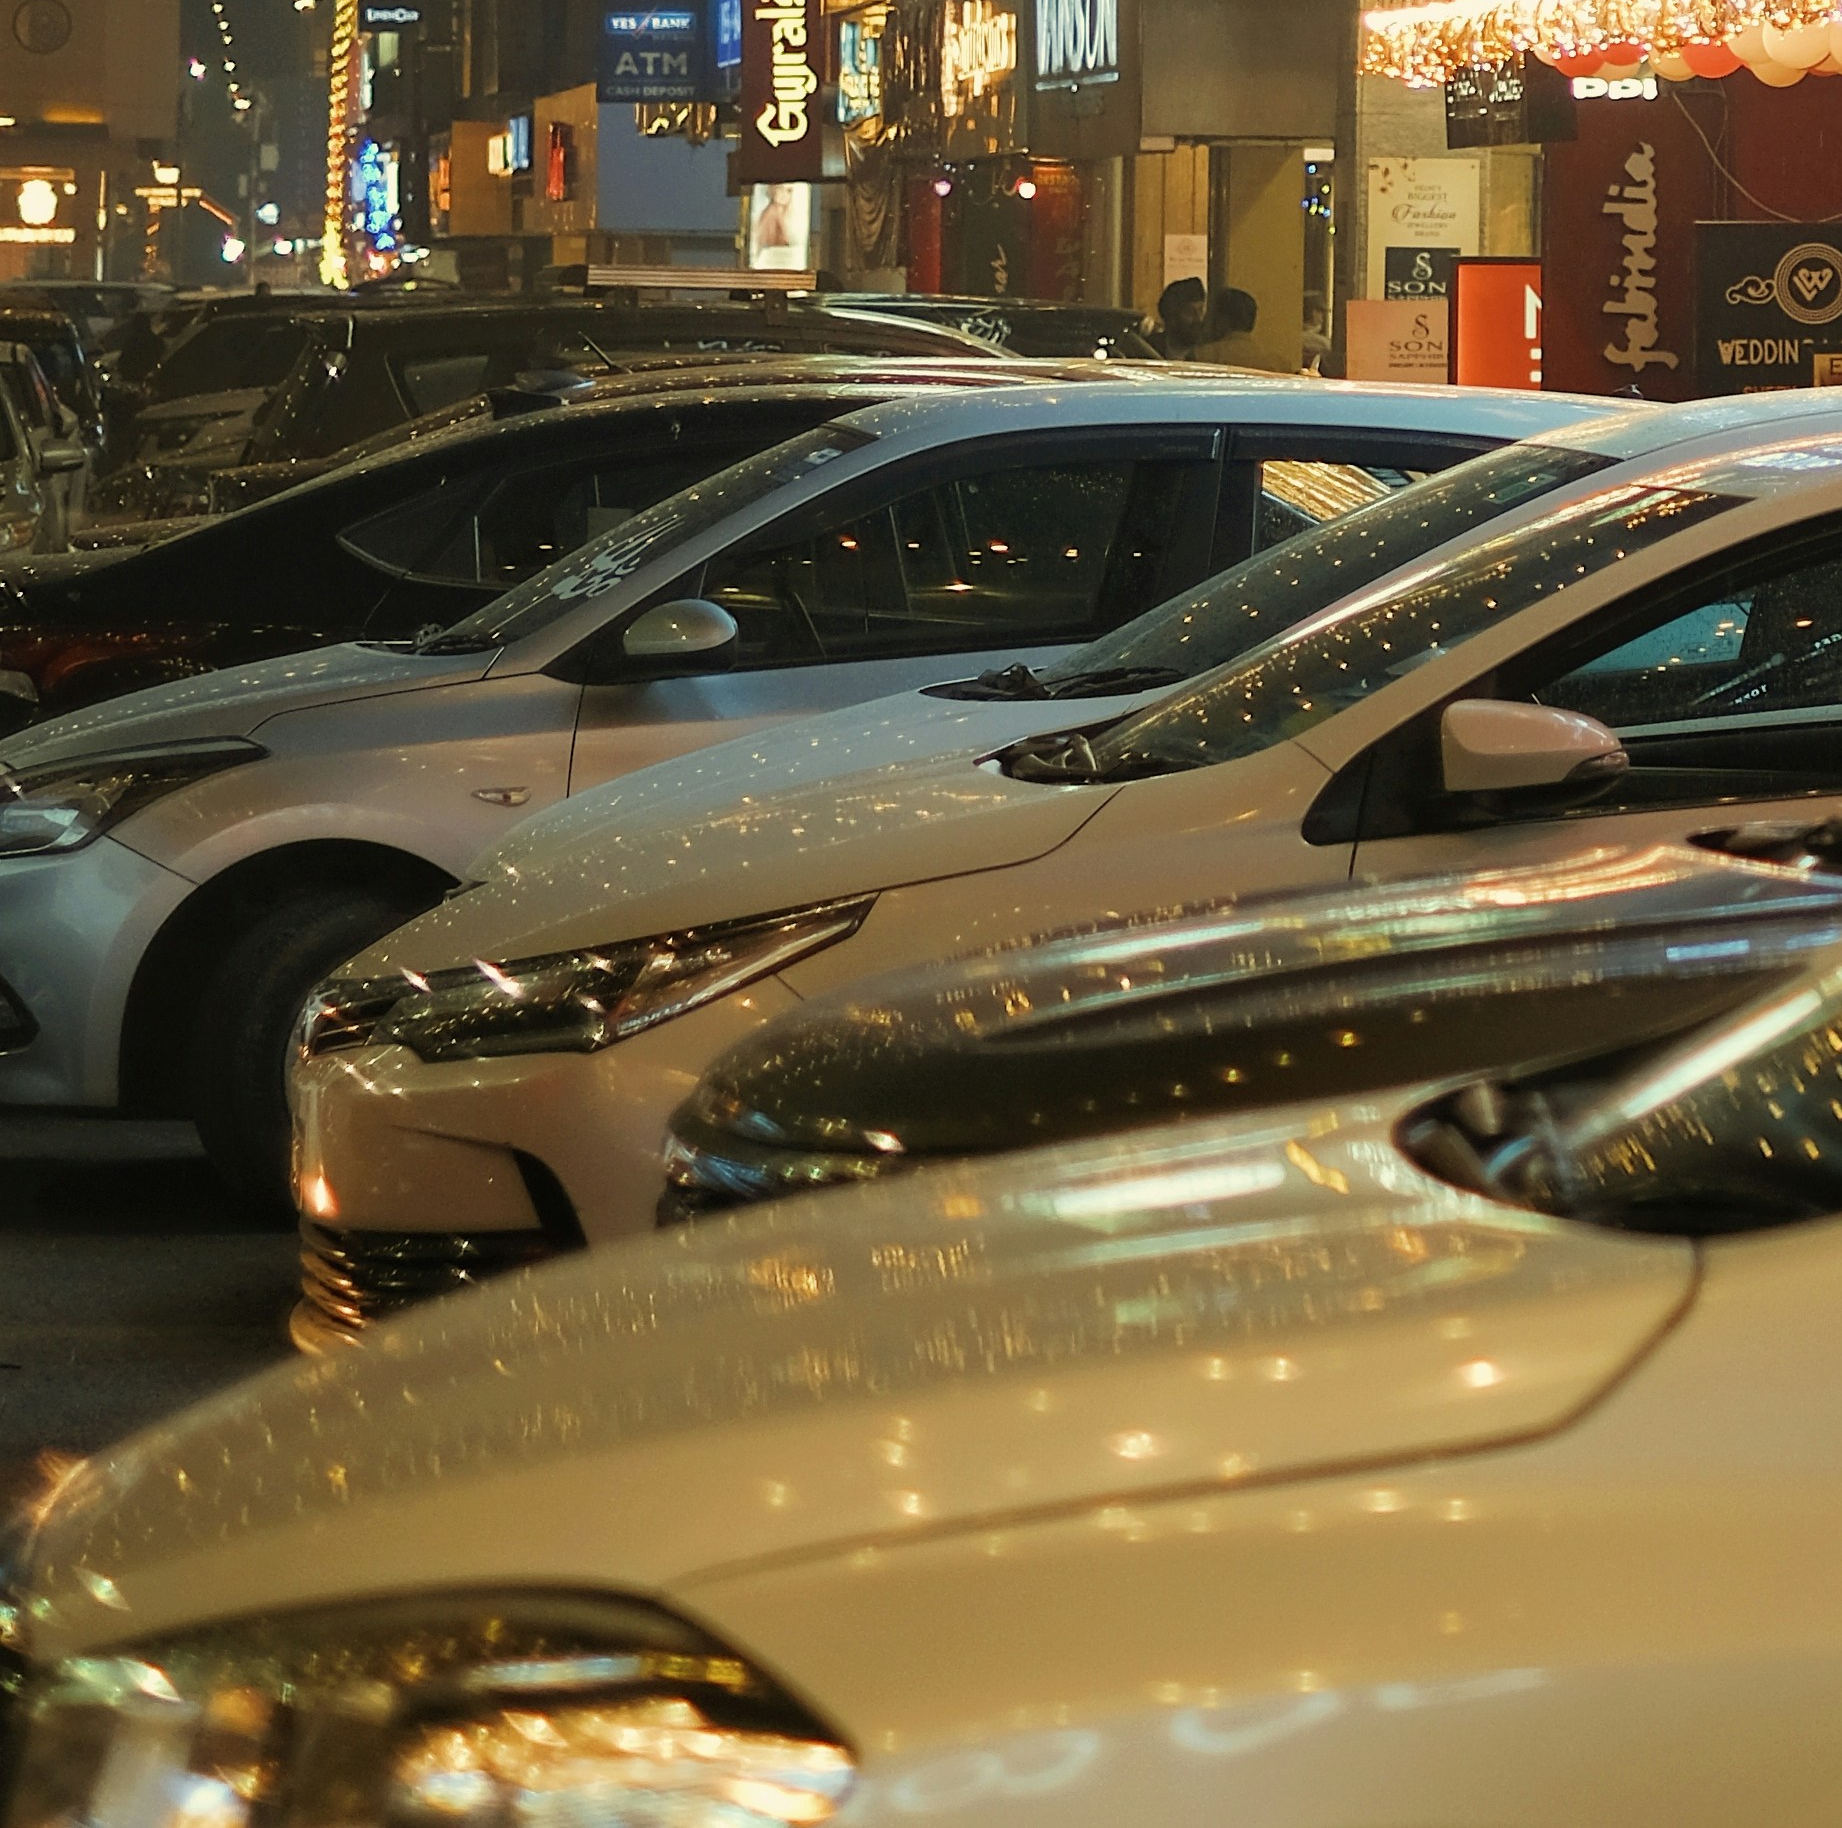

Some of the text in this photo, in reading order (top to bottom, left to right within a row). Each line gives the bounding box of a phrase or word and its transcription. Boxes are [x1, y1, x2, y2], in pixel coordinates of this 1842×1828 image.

[611, 17, 691, 30] YES BANK
[614, 51, 688, 76] ATM
[642, 85, 696, 97] DEPOSIT
[1603, 141, 1681, 373] fabindia
